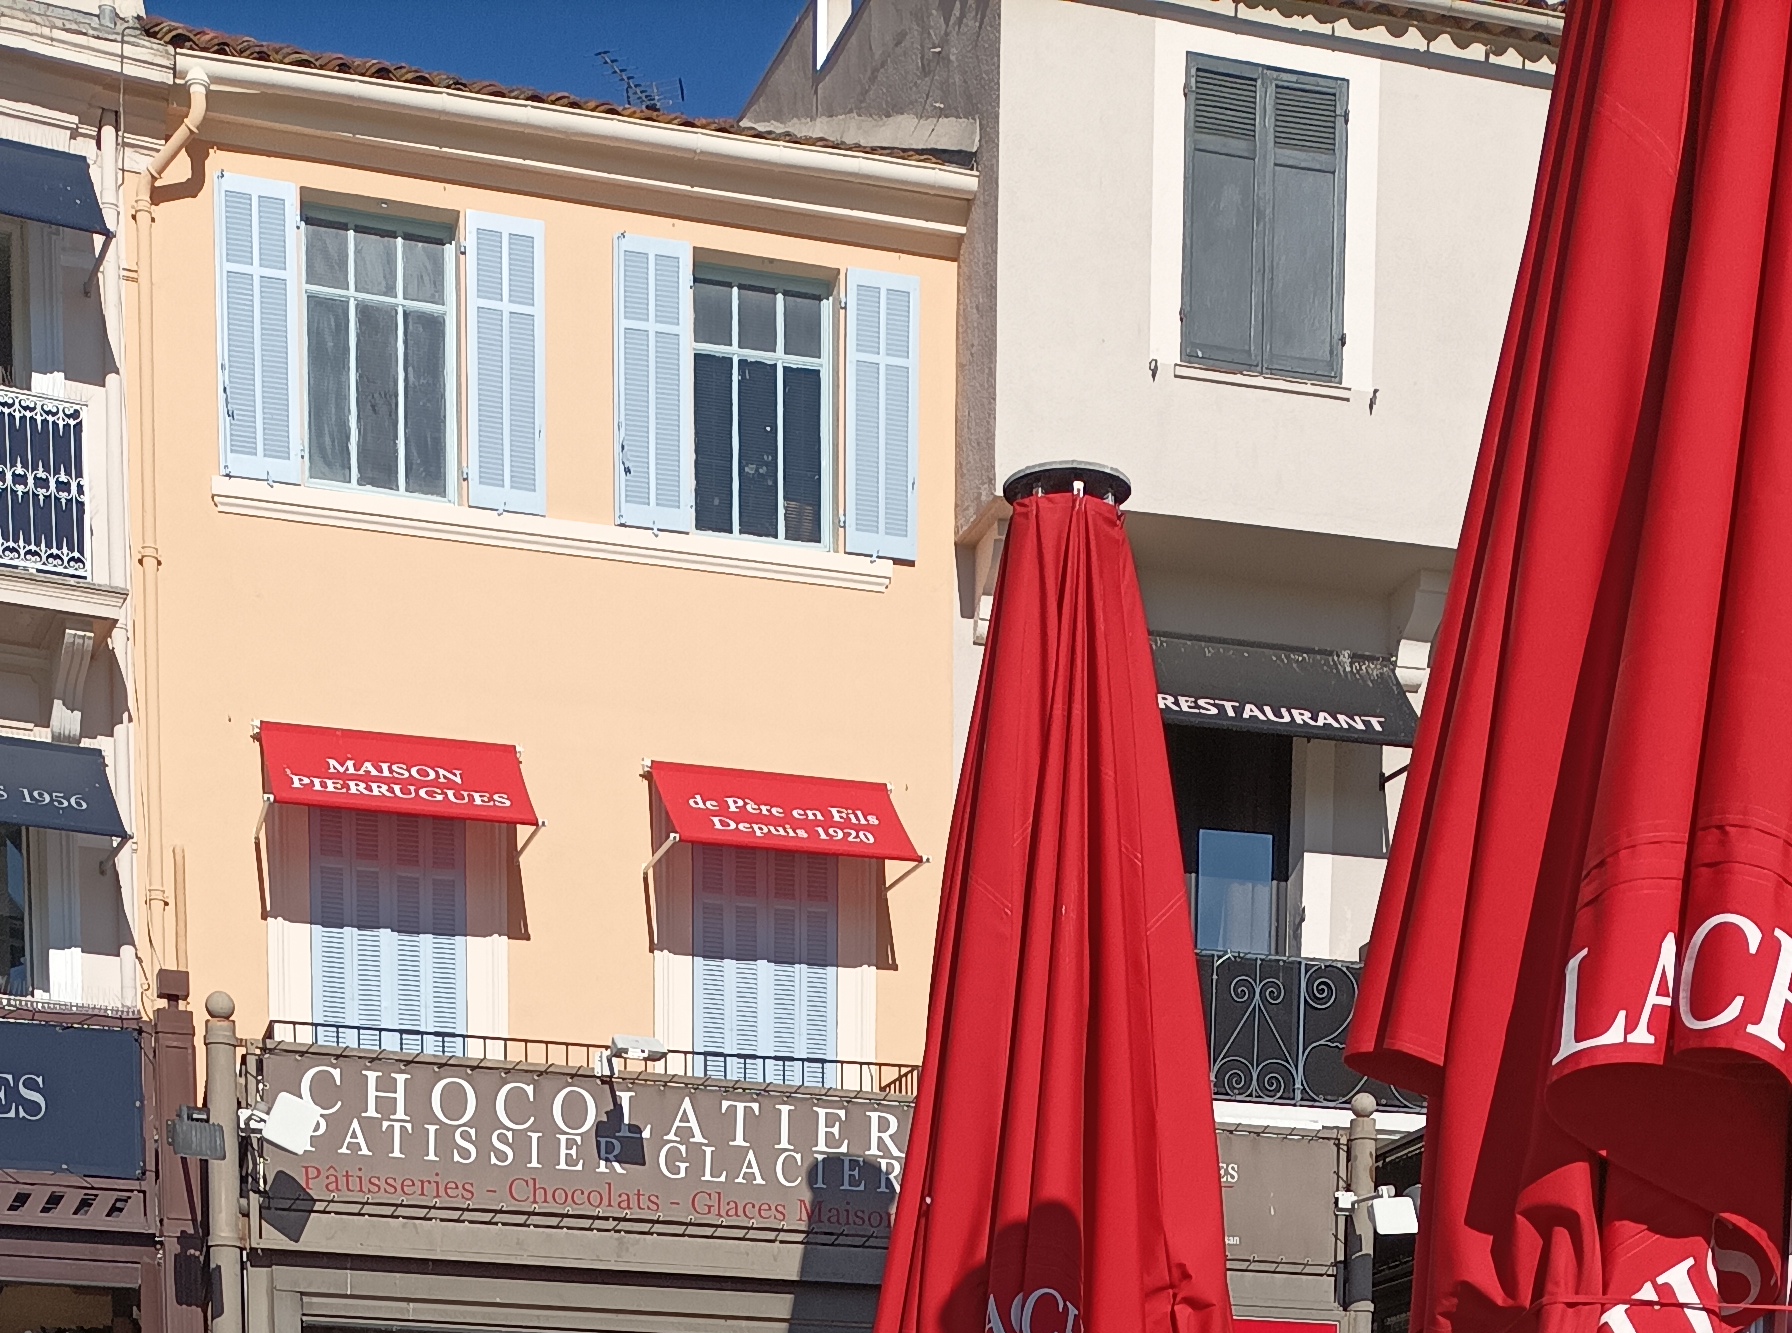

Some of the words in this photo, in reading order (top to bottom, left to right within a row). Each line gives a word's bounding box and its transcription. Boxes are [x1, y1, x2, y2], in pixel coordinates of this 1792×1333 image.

[1157, 693, 1385, 731] RESTAURANT
[326, 757, 463, 784] MAISON
[19, 788, 88, 810] 1956
[290, 774, 512, 807] PIERRUGUES
[689, 795, 719, 811] de
[724, 797, 785, 818] Père
[792, 808, 825, 821] en
[828, 807, 880, 826] Fils
[710, 816, 808, 839] Depuis
[815, 827, 875, 844] 1920
[300, 1065, 906, 1158] CHOCOLATIER
[308, 1116, 627, 1175] PATISSIER
[658, 1141, 901, 1194] GLACIER
[301, 1164, 476, 1200] Pâtisseries
[507, 1176, 661, 1212] Chocolats
[690, 1190, 787, 1222] Glaces
